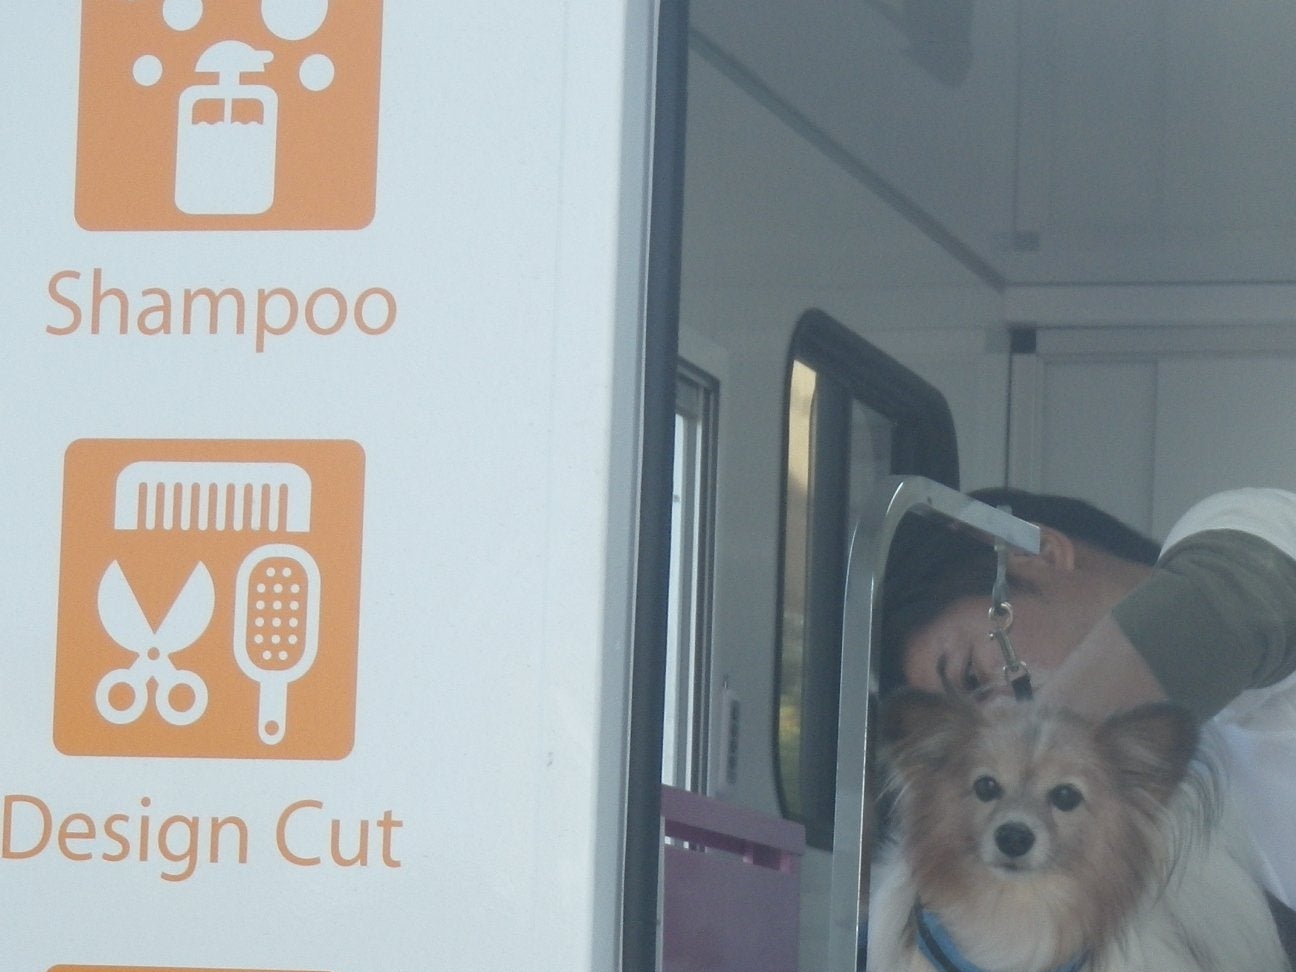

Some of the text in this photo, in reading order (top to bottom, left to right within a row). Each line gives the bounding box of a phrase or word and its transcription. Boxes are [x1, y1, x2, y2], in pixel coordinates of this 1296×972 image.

[45, 267, 398, 353] Shampoo
[1, 794, 404, 882] Design Cut
